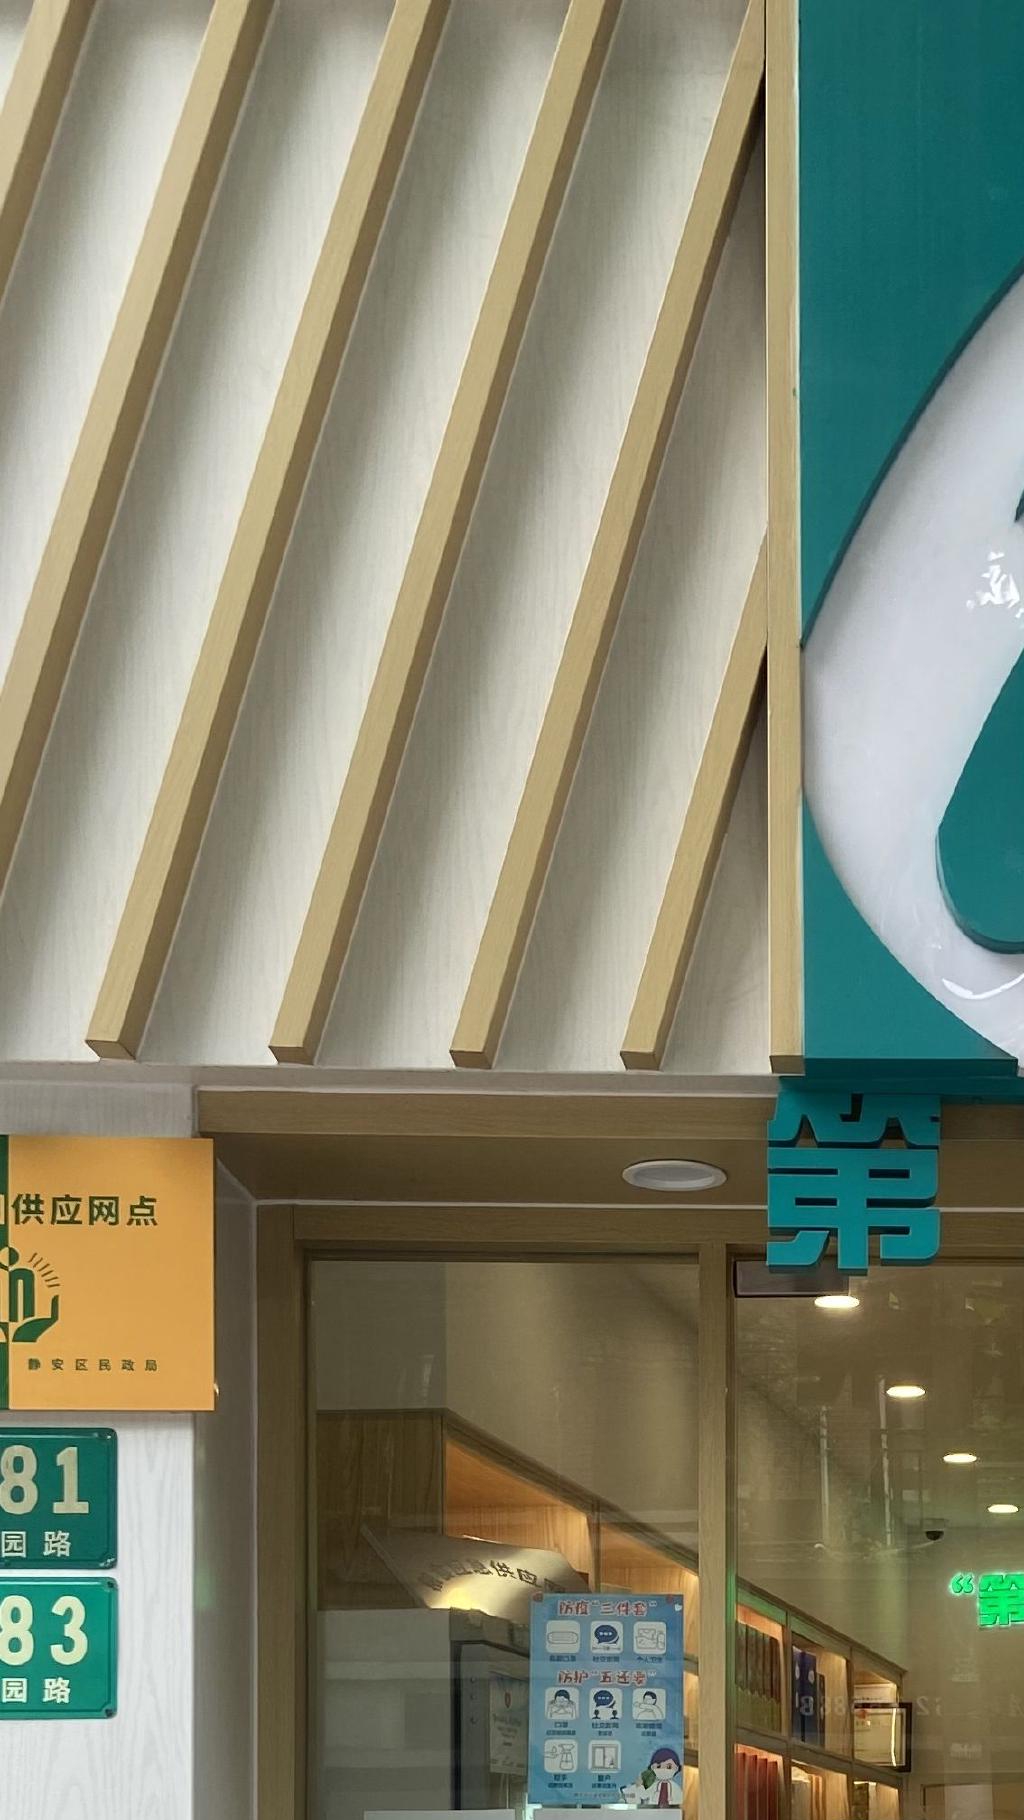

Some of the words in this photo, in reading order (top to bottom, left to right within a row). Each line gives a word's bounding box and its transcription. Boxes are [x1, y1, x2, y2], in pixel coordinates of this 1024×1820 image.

[0, 1194, 158, 1226] 供应网点
[27, 1358, 158, 1372] 静安区民政局
[0, 1446, 89, 1515] 81
[0, 1596, 88, 1666] 83
